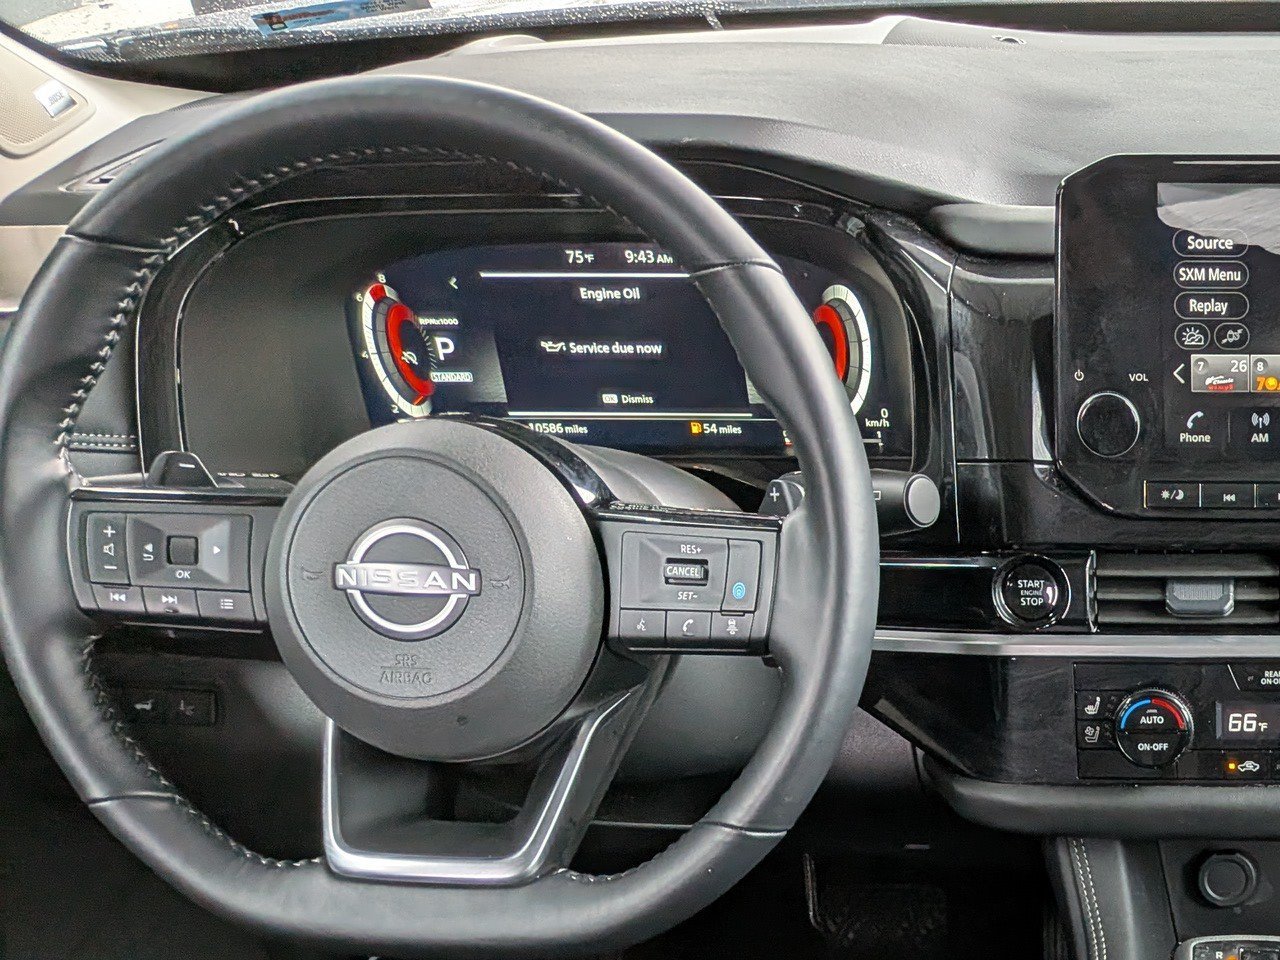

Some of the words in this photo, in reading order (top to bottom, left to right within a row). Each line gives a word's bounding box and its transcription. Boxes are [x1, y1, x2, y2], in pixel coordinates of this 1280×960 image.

[1187, 236, 1234, 250] Source
[624, 250, 655, 264] 9:43
[657, 254, 673, 264] AM
[1179, 268, 1206, 282] SXM
[1208, 268, 1241, 282] Menu
[579, 287, 621, 301] Engine
[623, 287, 641, 300] Oil
[1189, 299, 1228, 315] Replay
[434, 337, 455, 361] P
[569, 342, 610, 354] Service
[612, 341, 634, 354] due
[636, 344, 662, 354] now
[1230, 360, 1248, 372] 26
[431, 373, 472, 382] STANDARD
[1129, 373, 1148, 382] VOL
[621, 394, 653, 404] Dismiss
[881, 408, 889, 419] 0
[565, 423, 588, 434] miles
[703, 423, 717, 434] 54
[719, 423, 742, 434] miles
[865, 418, 890, 428] km/h
[1179, 433, 1211, 443] Phone
[1251, 433, 1269, 443] AM
[175, 570, 191, 579] OK
[666, 566, 699, 576] CANCEL
[338, 568, 476, 591] NISSAN
[1017, 580, 1045, 588] START
[1020, 597, 1044, 606] STOP
[395, 654, 418, 667] SRS
[1140, 716, 1164, 725] AUTO
[1215, 951, 1223, 959] R
